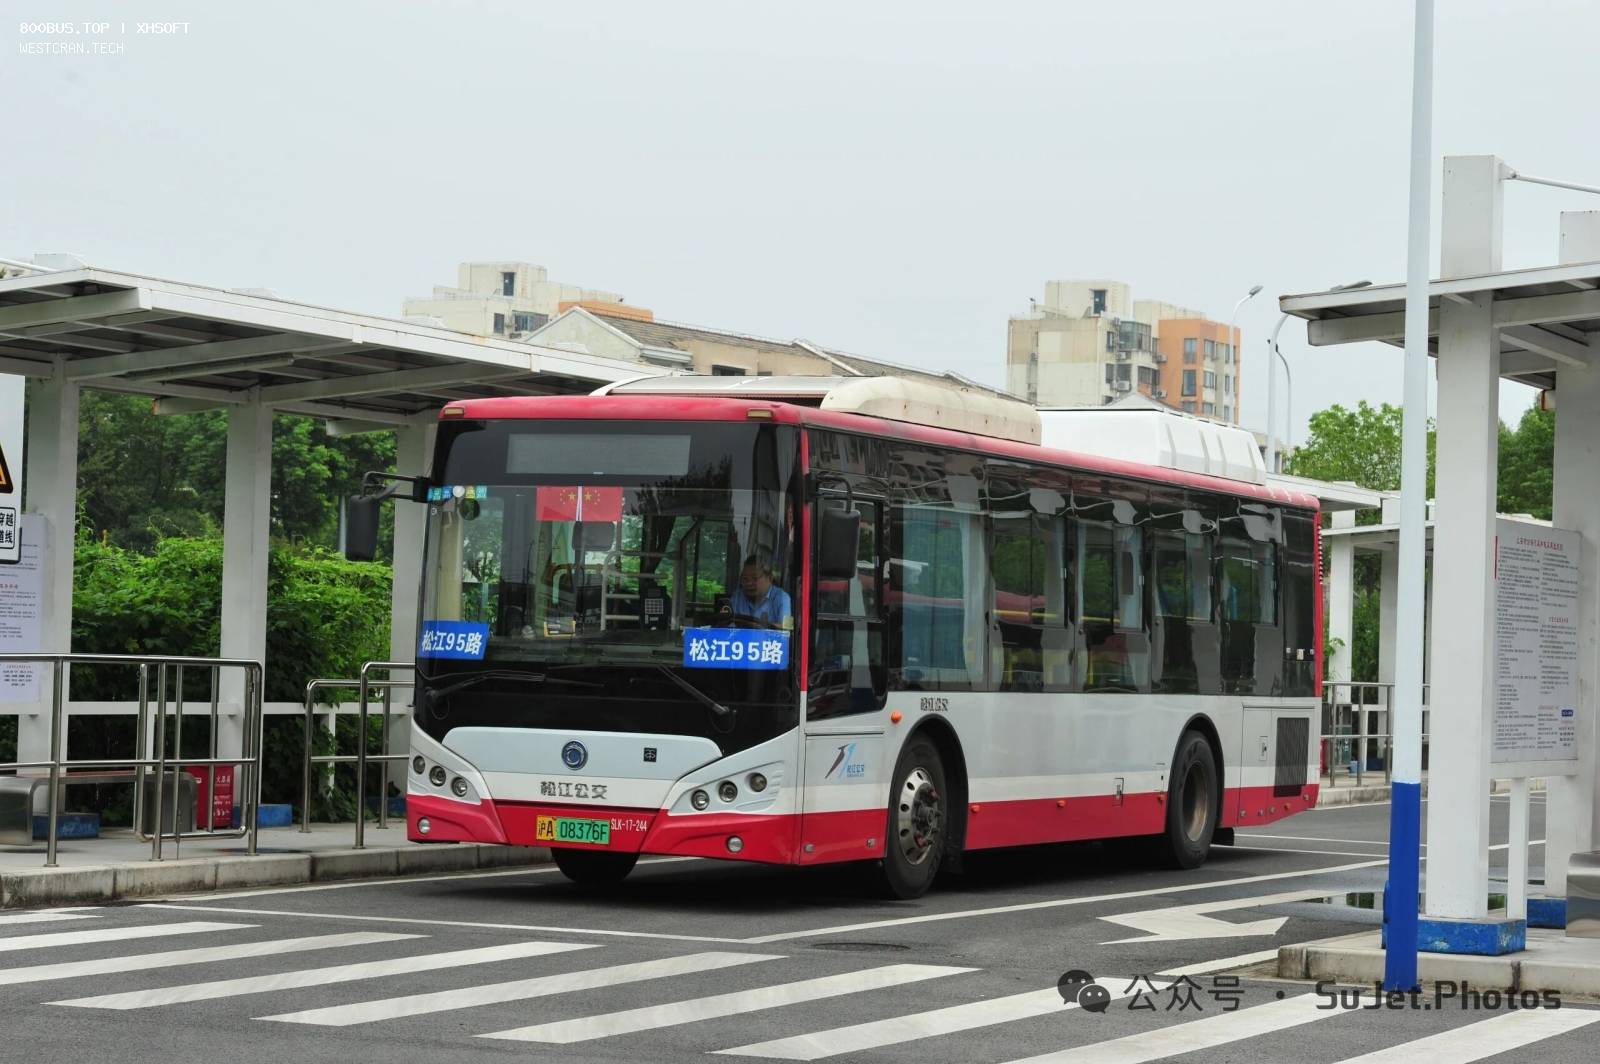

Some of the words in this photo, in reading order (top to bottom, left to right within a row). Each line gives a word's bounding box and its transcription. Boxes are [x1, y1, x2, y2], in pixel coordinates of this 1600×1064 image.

[422, 629, 482, 655] 松江95路
[689, 638, 784, 665] 松江95路
[540, 781, 608, 800] 松江公交
[610, 819, 648, 832] SLK-17-244
